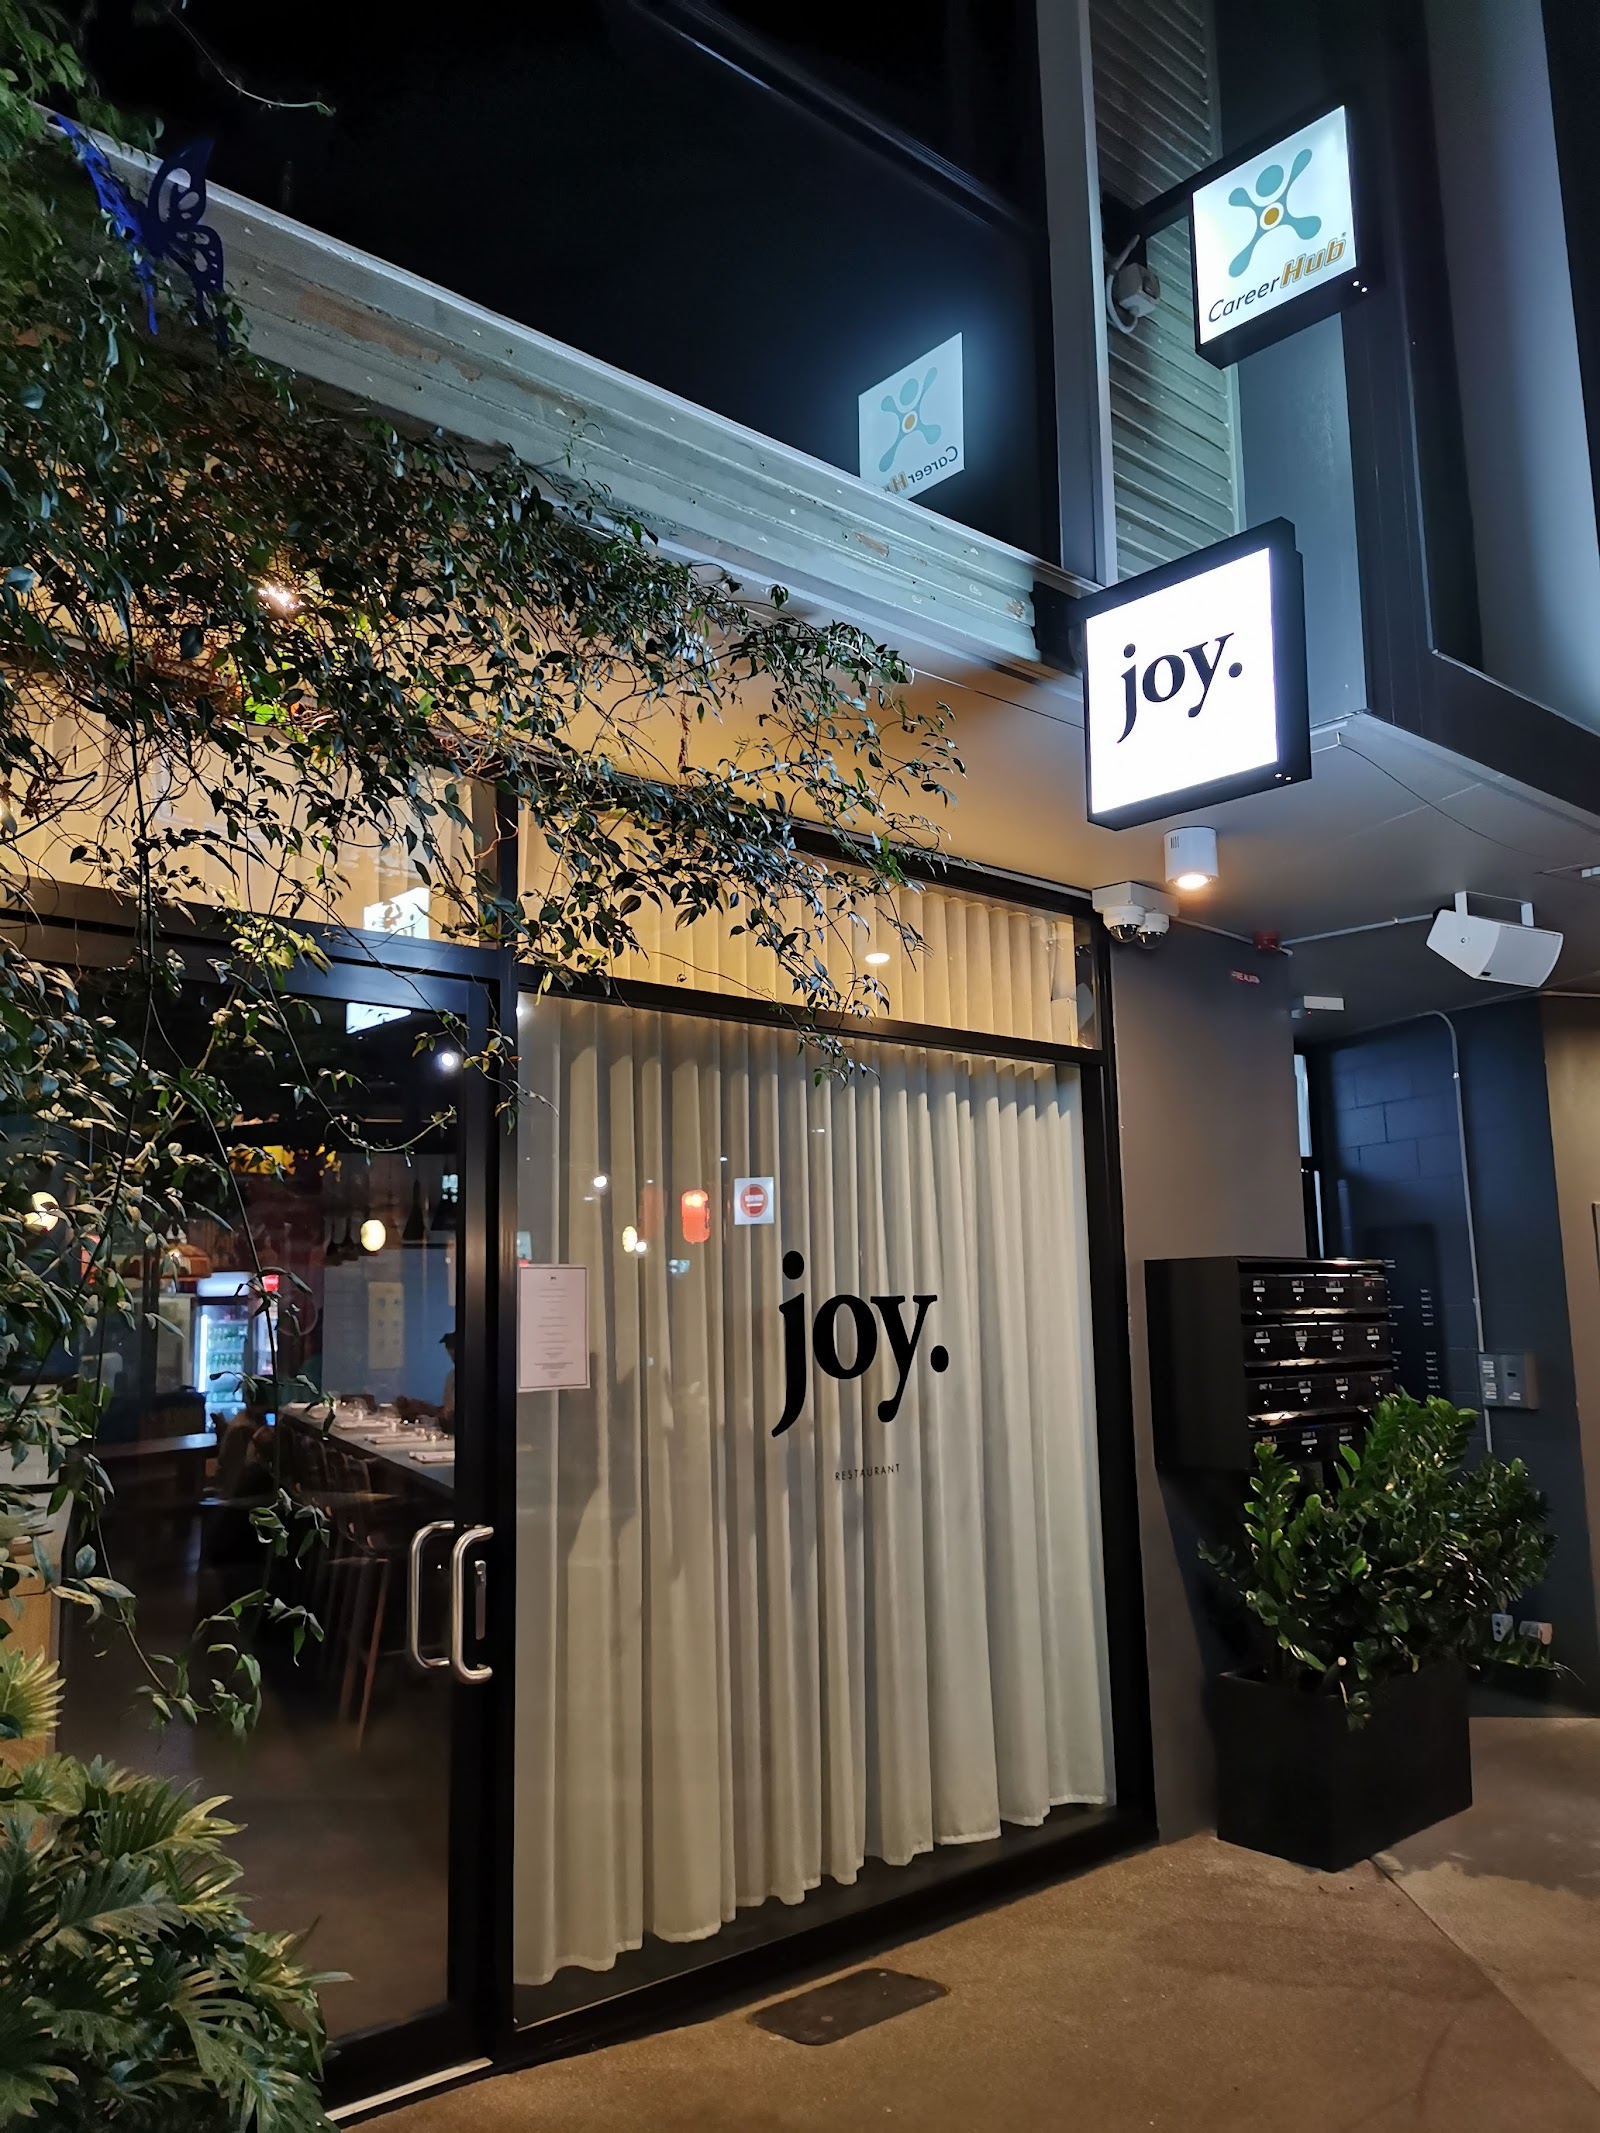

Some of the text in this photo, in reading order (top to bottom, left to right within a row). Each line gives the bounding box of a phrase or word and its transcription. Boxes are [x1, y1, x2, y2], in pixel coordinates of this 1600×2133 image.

[1116, 632, 1243, 744] joy.
[771, 1250, 949, 1438] joy.
[834, 1463, 900, 1481] RESTAURANT
